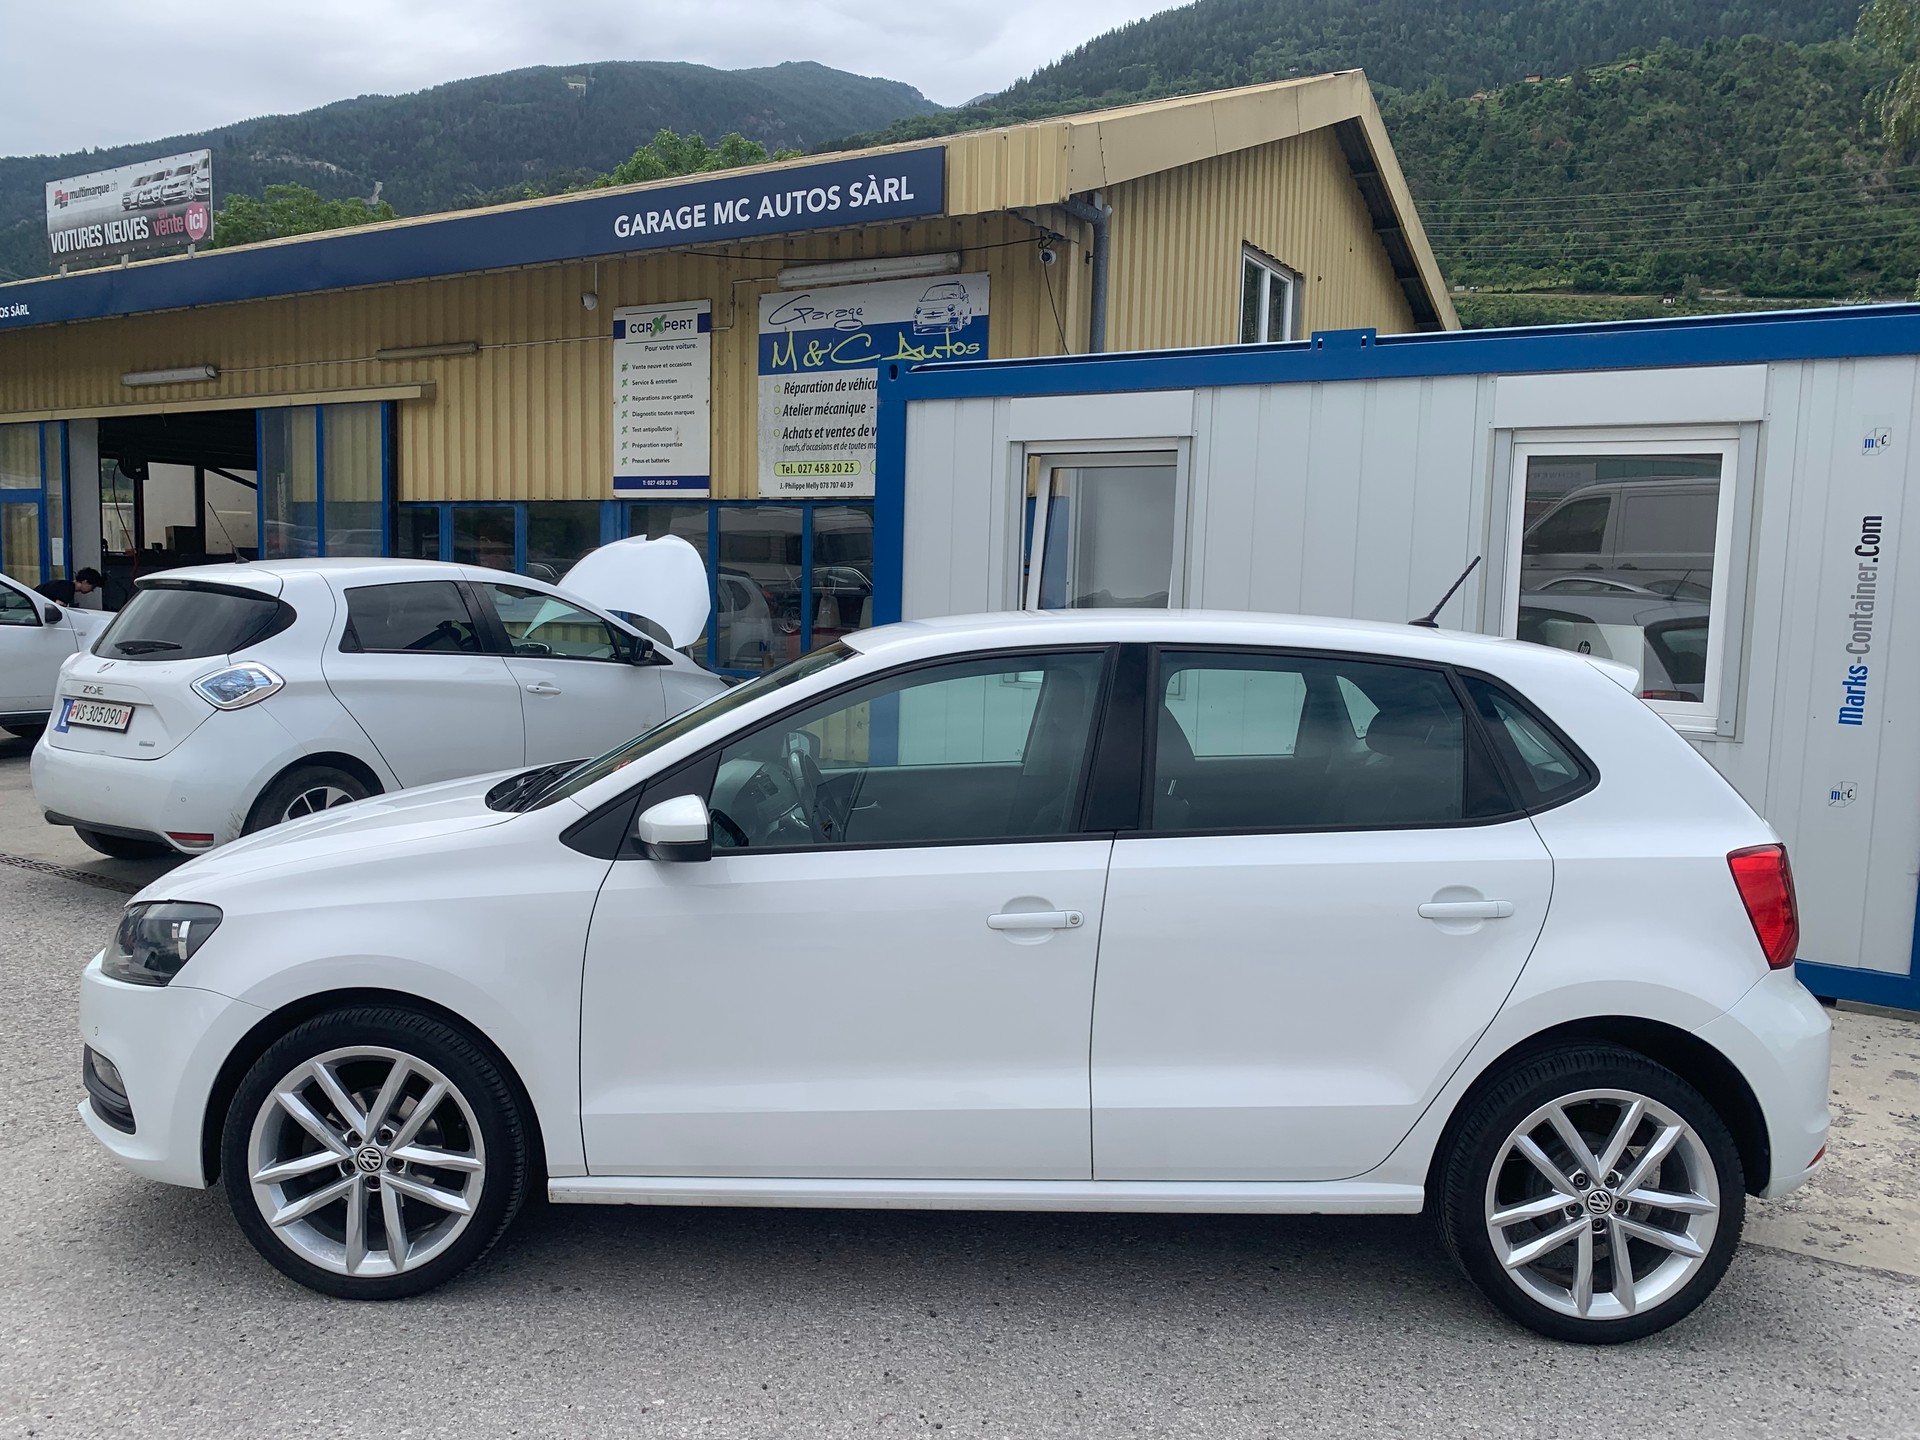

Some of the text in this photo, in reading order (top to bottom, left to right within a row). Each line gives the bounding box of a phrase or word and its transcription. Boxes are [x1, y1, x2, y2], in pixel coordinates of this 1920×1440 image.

[614, 174, 914, 238] GARAGE MC AUTOS SÀRL
[50, 208, 203, 254] VOITURES NEUVES vente ici
[768, 294, 864, 330] Garage
[675, 342, 698, 350] voiture.
[772, 327, 980, 372] M & C Autos
[783, 380, 832, 397] Réparation
[835, 379, 846, 391] de
[632, 394, 660, 402] Réparations
[673, 393, 693, 401] garantie
[782, 403, 813, 417] Atelier
[814, 402, 866, 417] mécanique
[643, 425, 673, 433] antipollution
[782, 426, 812, 440] Achats
[814, 427, 823, 438] et
[825, 426, 856, 438] ventes
[858, 424, 869, 437] de
[840, 442, 847, 450] de
[848, 442, 866, 450] toutes
[781, 462, 855, 474] Tel. 027 458 20 25
[805, 482, 819, 490] Melly
[1838, 515, 1883, 726] Marks-Container.Com
